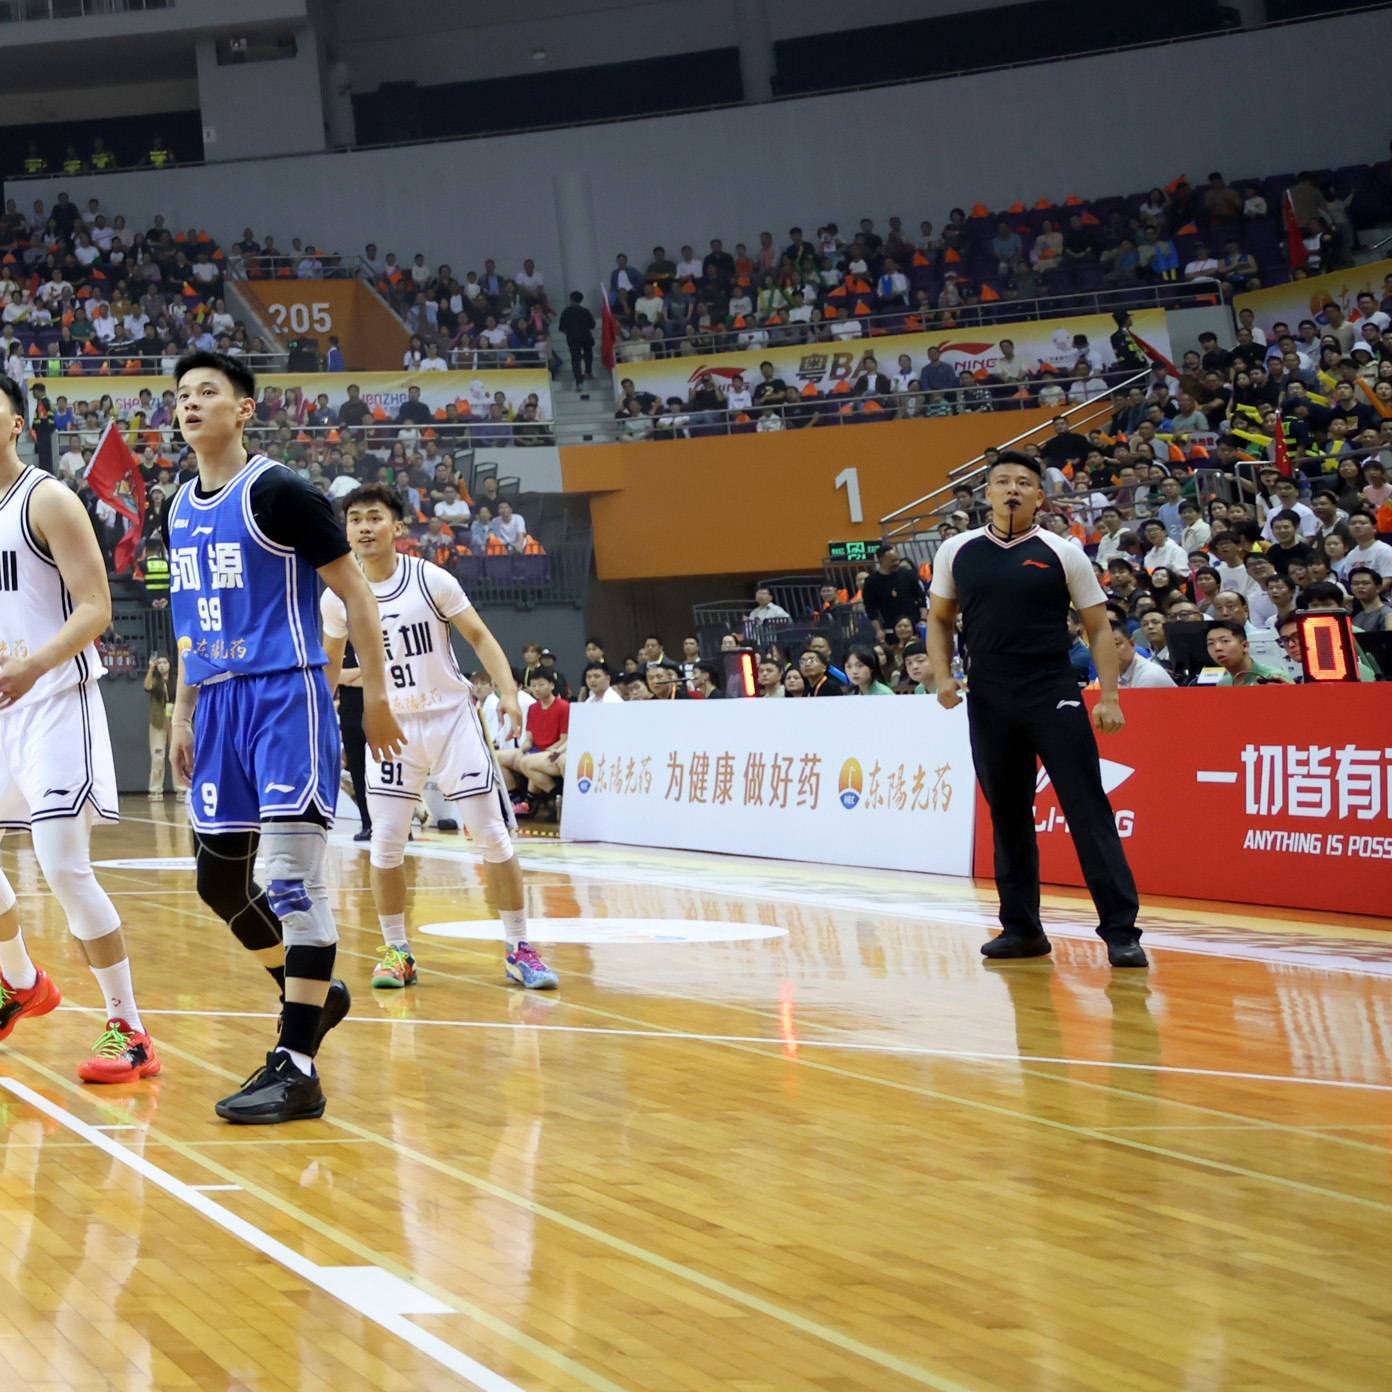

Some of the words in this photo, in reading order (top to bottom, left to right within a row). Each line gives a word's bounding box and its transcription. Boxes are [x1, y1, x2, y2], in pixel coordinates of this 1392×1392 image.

[268, 302, 332, 333] 205
[835, 467, 864, 523] 1
[170, 542, 244, 593] 河源
[197, 597, 223, 631] 99
[1303, 616, 1347, 680] 0
[390, 664, 417, 688] 91
[381, 761, 404, 786] 91
[664, 750, 736, 805] 为健康
[743, 751, 821, 811] 做好药
[1032, 806, 1135, 838] LI-G
[1243, 829, 1322, 856] ANYTHING
[1326, 834, 1343, 856] IS
[1349, 835, 1392, 860] POSS
